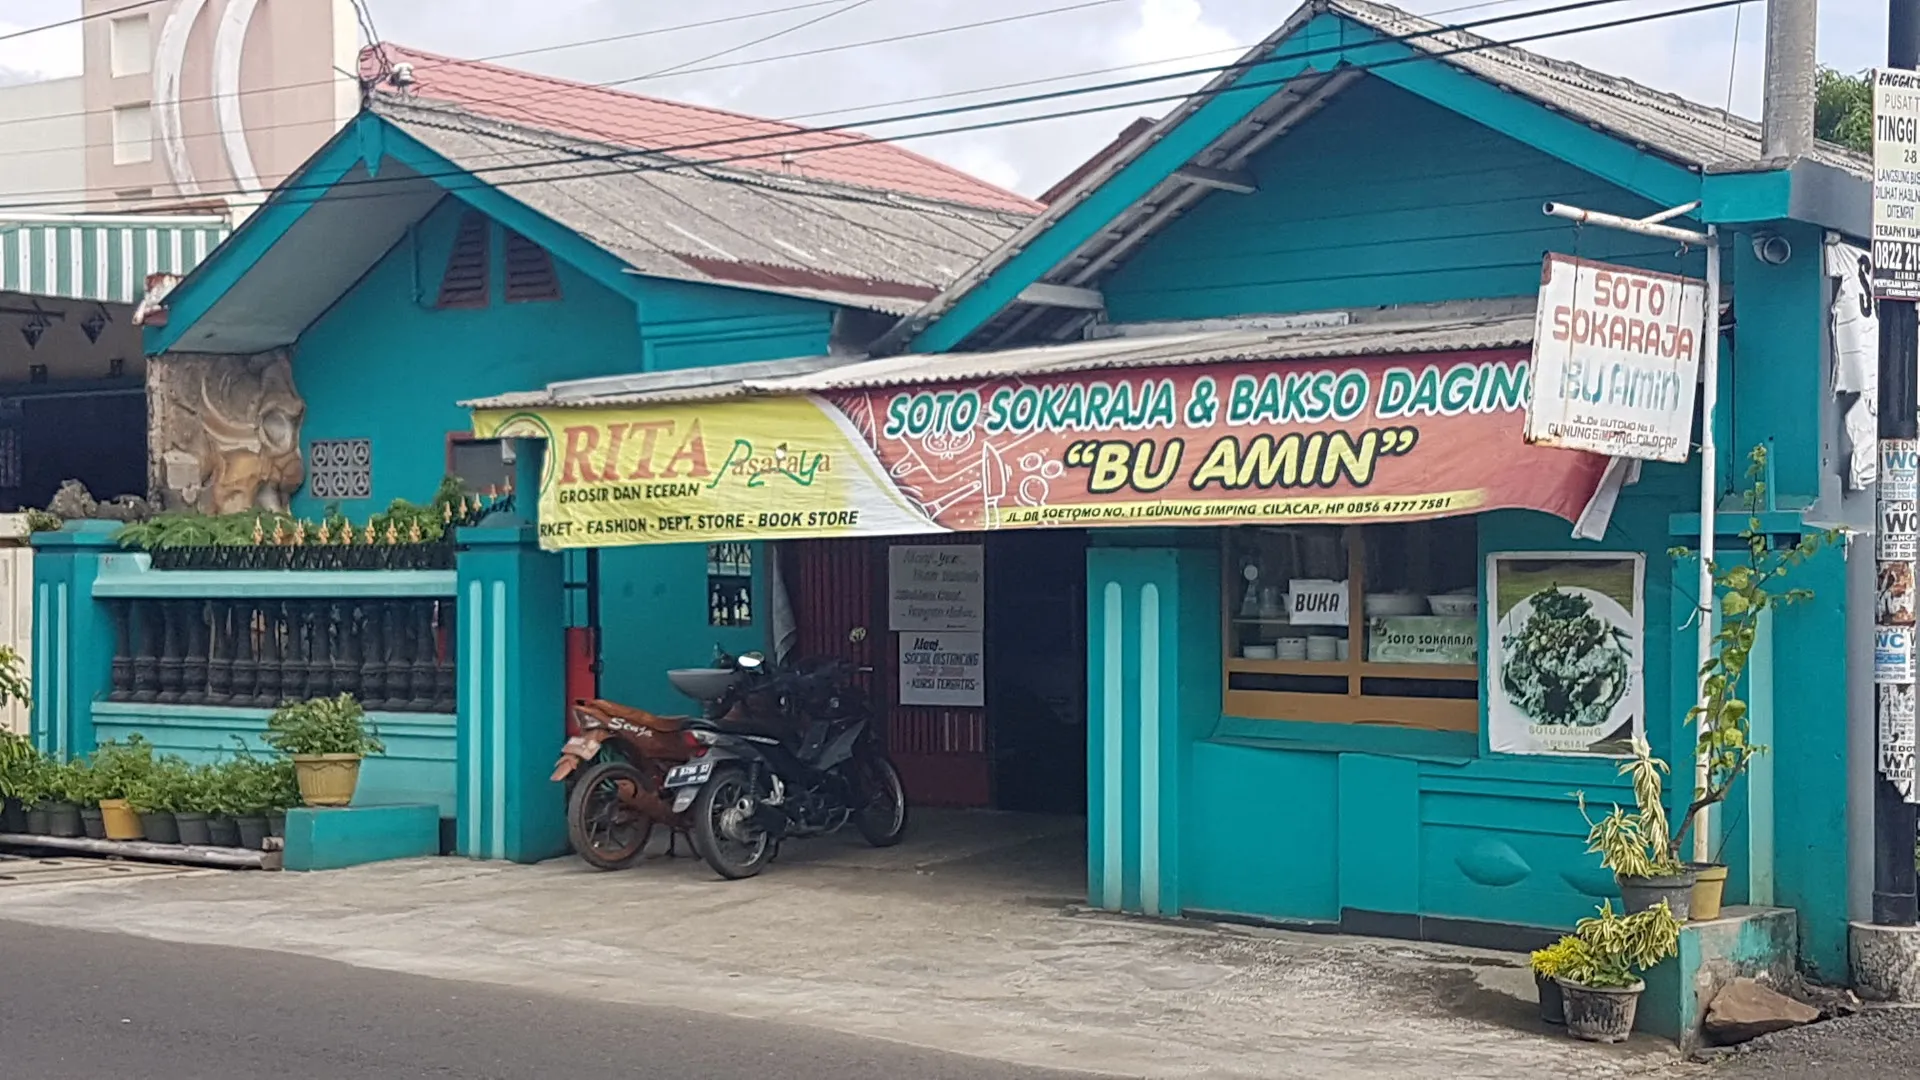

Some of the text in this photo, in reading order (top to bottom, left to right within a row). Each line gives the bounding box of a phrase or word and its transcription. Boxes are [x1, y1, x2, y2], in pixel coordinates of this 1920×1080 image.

[1884, 93, 1912, 111] PUSAT
[1877, 114, 1917, 144] TINGGI
[1875, 241, 1902, 270] 0822
[1593, 271, 1665, 316] SOTO
[1552, 305, 1694, 362] SOKARAJA
[885, 390, 980, 438] SOTO
[985, 378, 1174, 433] SOKARAJA
[1187, 377, 1216, 427] &
[1227, 370, 1368, 423] BAKSO
[558, 418, 712, 486] RITA
[559, 483, 700, 504] GROSIR DAN ECERAN
[1042, 507, 1100, 519] SOETOMO
[1146, 505, 1200, 516] GUNUNG
[1203, 503, 1257, 516] SIMPING
[1325, 502, 1344, 514] HP
[1347, 501, 1379, 513] 0856
[1383, 499, 1417, 512] 4777
[1419, 497, 1451, 511] 7581
[587, 518, 647, 534] FASHION
[658, 515, 693, 531] DEPT.
[698, 513, 745, 529] STORE
[758, 511, 803, 527] BOOK
[808, 510, 859, 526] STORE
[1295, 592, 1340, 612] BUKA
[1387, 634, 1415, 644] SOTO
[1529, 725, 1602, 737] SOTO DAGING
